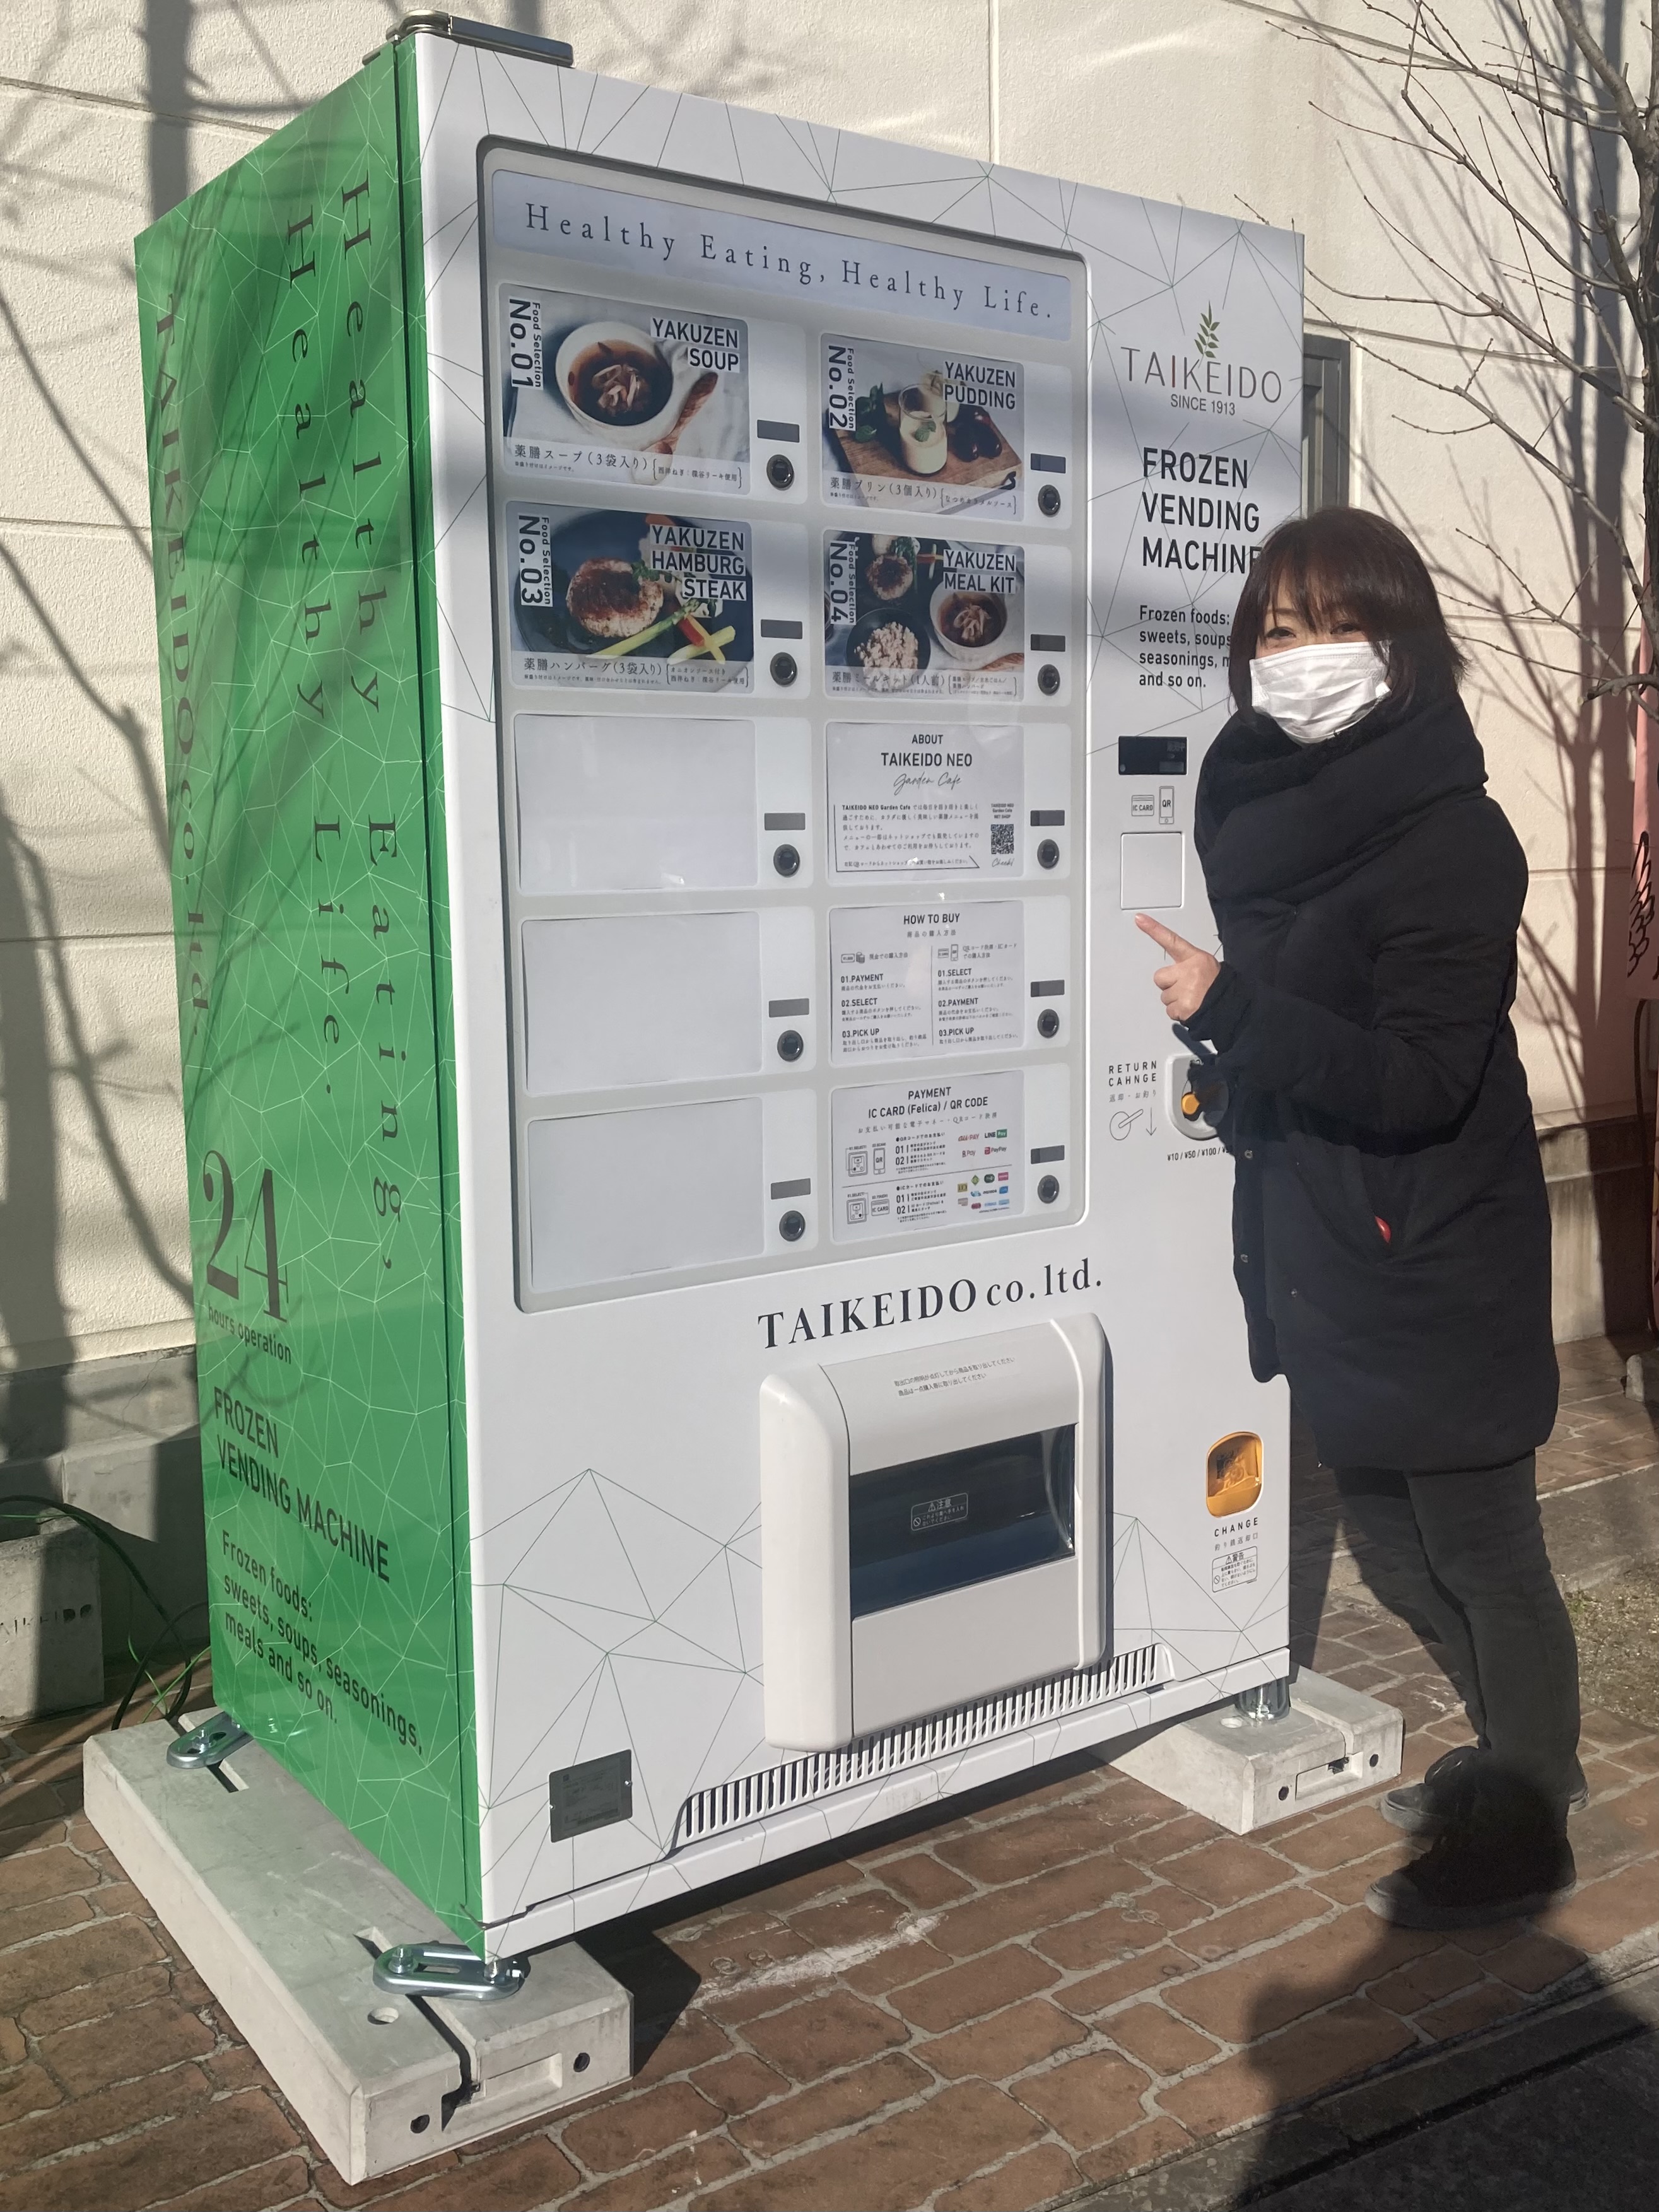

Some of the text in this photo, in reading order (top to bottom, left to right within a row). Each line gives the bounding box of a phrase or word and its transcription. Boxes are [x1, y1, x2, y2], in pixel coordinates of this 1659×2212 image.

[525, 202, 1050, 318] Healthy Eating, Healthy Life.
[509, 298, 533, 388] No.01
[653, 318, 739, 348] YAKUZEN
[532, 302, 542, 387] Food Selection
[689, 348, 739, 371] SOUP
[945, 361, 1016, 387] YAKUZEN
[1120, 346, 1281, 403] TAIKEIDO
[828, 346, 847, 427] No.02
[945, 385, 1016, 409] PUDDING
[1171, 394, 1235, 416] SINCE 1913
[1143, 447, 1248, 488] FROZEN
[1142, 491, 1259, 532] VENDING
[157, 294, 193, 754] TAIKEIDO
[652, 525, 744, 551] YAKUZEN
[518, 515, 543, 604] No.03
[541, 517, 551, 604] Food Selection
[652, 551, 744, 575] HAMBURG
[945, 551, 1015, 571] YAKUZEN
[684, 579, 745, 600] STEAK
[830, 542, 848, 622] No.04
[945, 573, 1015, 593] MEAL KIT
[1139, 605, 1229, 625] Frozen foods:
[1139, 631, 1190, 645] sweets,
[288, 205, 349, 1094] Healthy Life.
[1139, 652, 1217, 669] seasonings,
[1139, 671, 1205, 688] and so on.
[342, 170, 406, 1269] Healthy Eating,
[912, 734, 944, 744] ABOUT
[881, 752, 972, 766] TAIKEIDO NEO
[893, 771, 963, 795] Garden Cafe
[1162, 799, 1171, 807] QR
[903, 913, 960, 925] HOW TO BUY
[841, 973, 883, 983] 01.PAYMENT
[938, 968, 971, 977] 01.SELECT
[841, 998, 877, 1007] 02.SELECT
[938, 998, 978, 1007] 02.PAYMENT
[842, 1029, 869, 1038] 03.PICK
[939, 1028, 963, 1036] 03.PICK
[1108, 1060, 1157, 1074] RETURN
[1108, 1073, 1157, 1087] CAHNGE
[908, 1087, 951, 1100] PAYMENT
[868, 1096, 988, 1118] IC CARD (Felica) QR CODE
[895, 1145, 903, 1154] 01
[1167, 1152, 1178, 1161] ¥10
[1185, 1150, 1195, 1159] ¥50
[1202, 1147, 1216, 1156] ¥100
[895, 1157, 905, 1165] 02
[896, 1195, 905, 1203] 01
[896, 1205, 905, 1214] 02
[203, 1150, 288, 1323] 24
[758, 1279, 976, 1349] TAIKEIDO
[208, 1300, 291, 1364] hours operation
[214, 1386, 279, 1458] FROZEN
[217, 1434, 389, 1583] VENDING MACHINE
[1214, 1517, 1258, 1536] CHANGE
[223, 1530, 312, 1622] Frozen foods:
[224, 1574, 423, 1755] sweets, soups, seasonings,
[225, 1610, 337, 1724] meals and so on.
